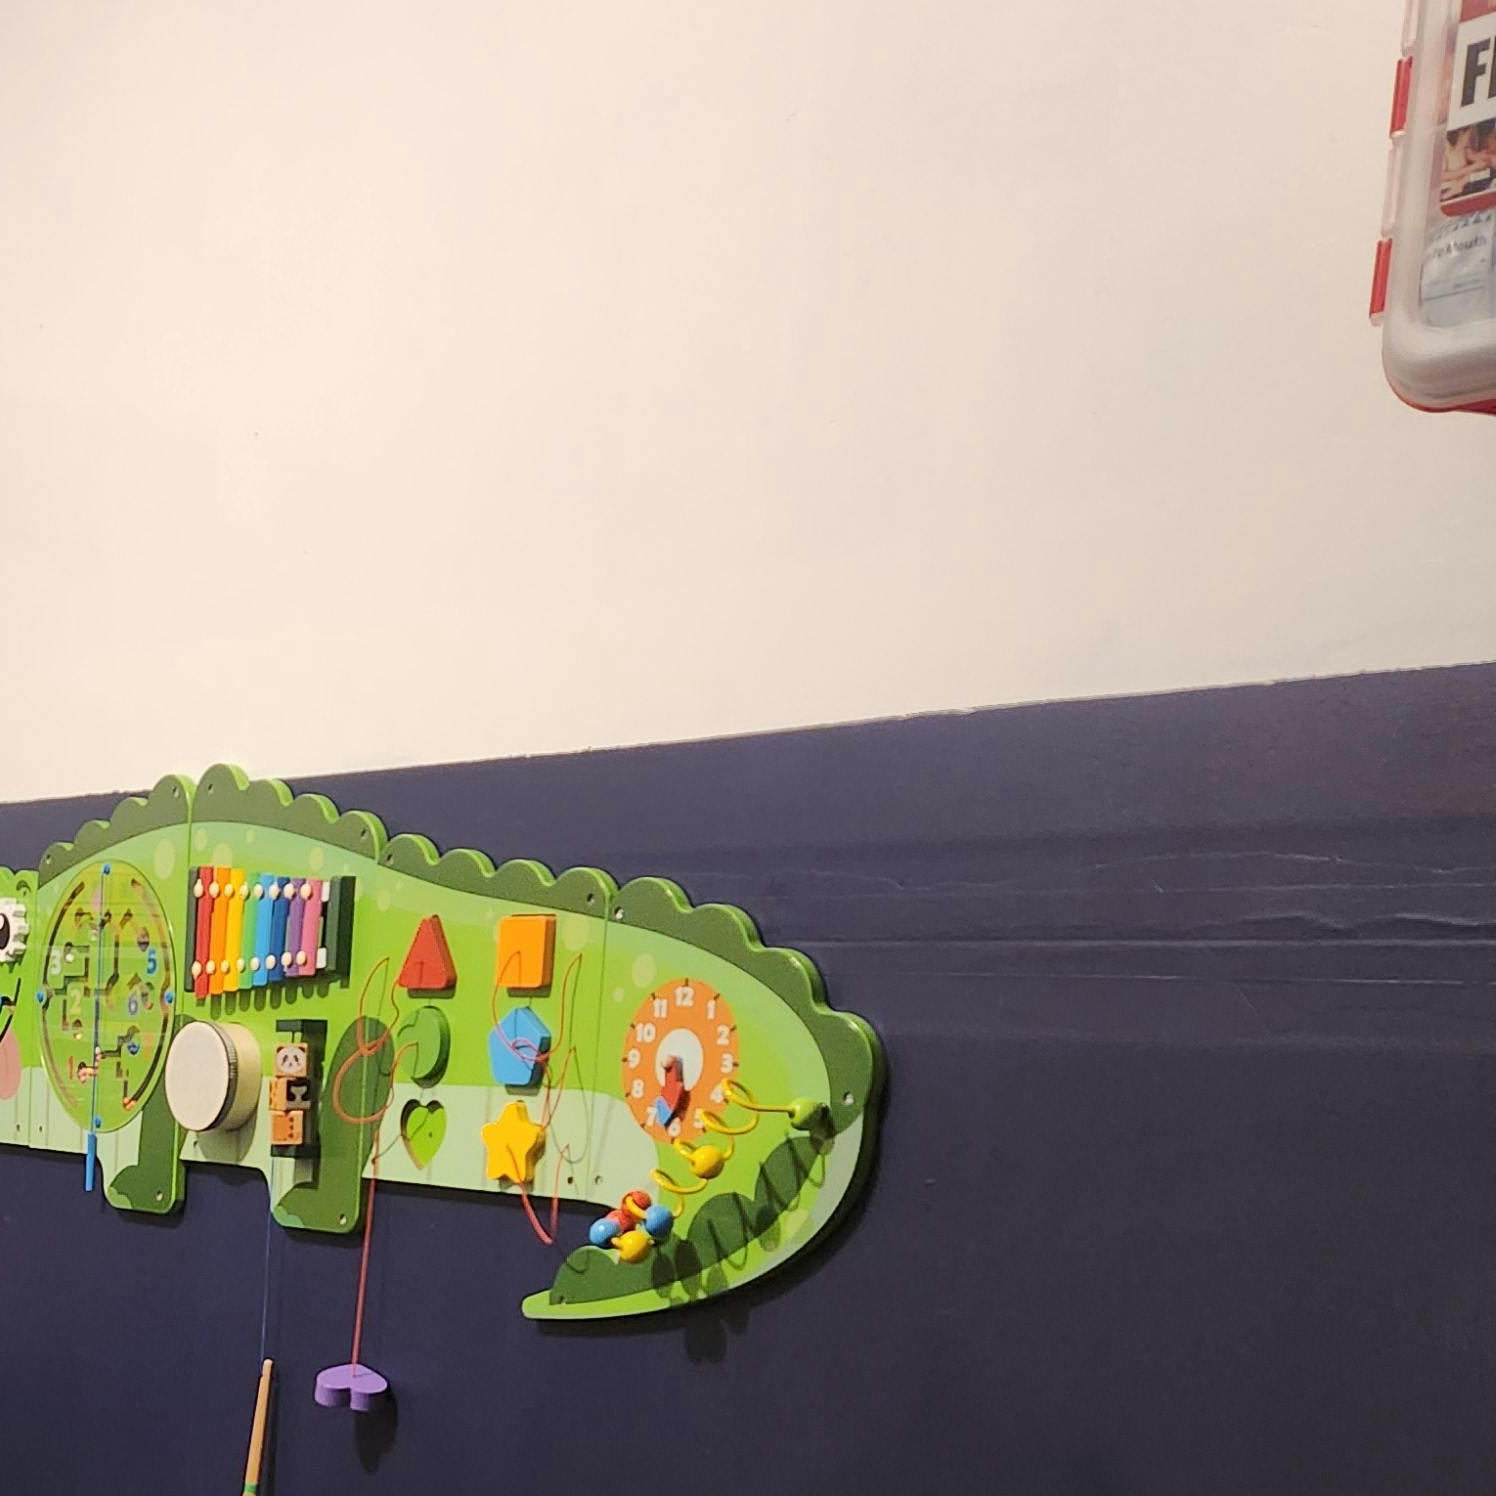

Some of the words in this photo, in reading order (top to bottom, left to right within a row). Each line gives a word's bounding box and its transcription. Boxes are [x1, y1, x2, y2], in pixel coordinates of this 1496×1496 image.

[147, 949, 157, 975] 5
[128, 992, 138, 1016] 6
[675, 986, 694, 1007] 12
[653, 998, 668, 1018] 11
[707, 999, 716, 1020] 1
[636, 1022, 656, 1044] 10
[716, 1025, 730, 1046] 2
[628, 1048, 641, 1069] 9
[720, 1052, 734, 1074] 3
[631, 1079, 645, 1099] 8
[668, 1117, 681, 1138] 6
